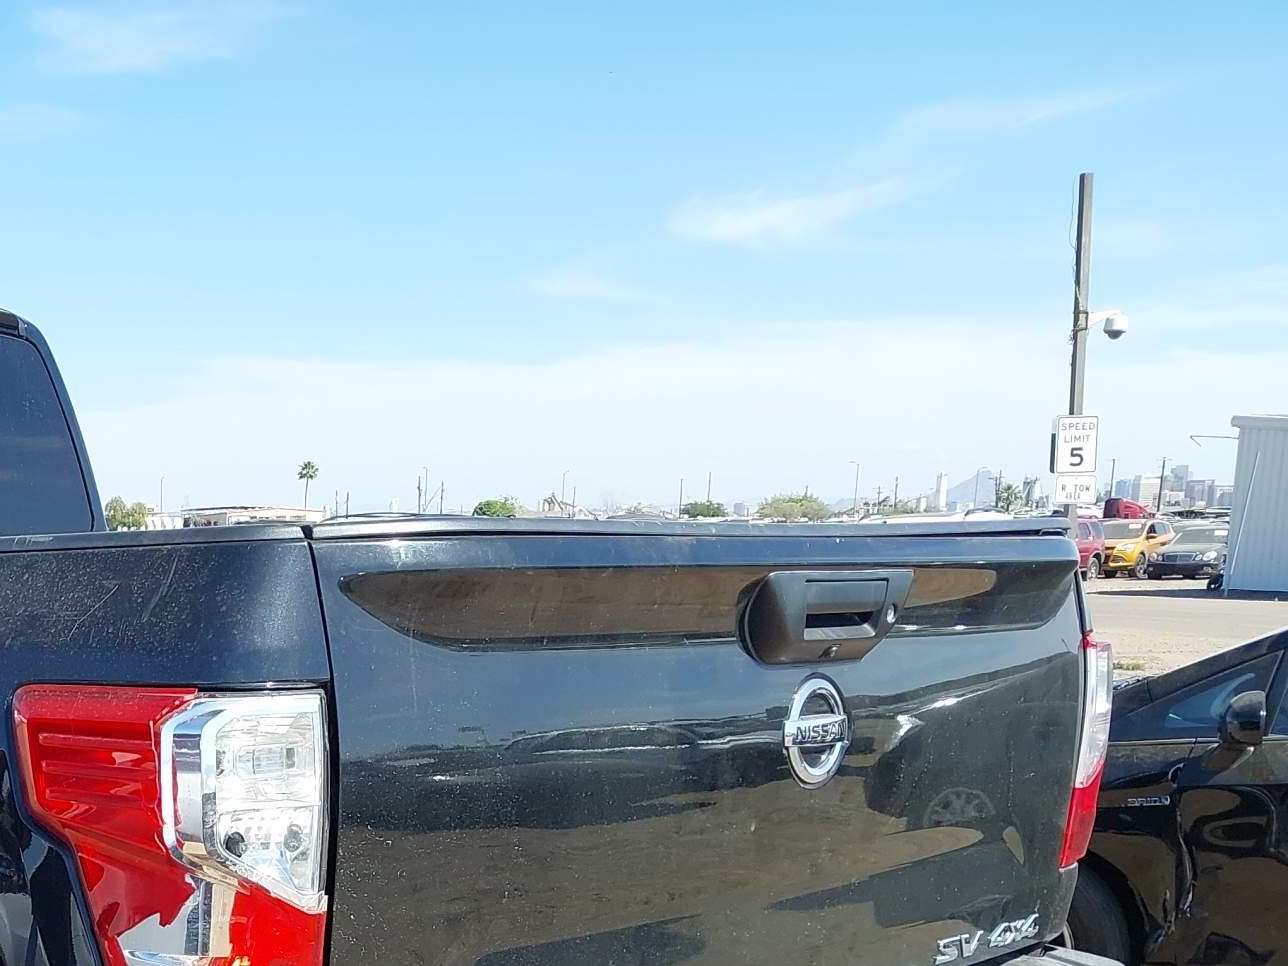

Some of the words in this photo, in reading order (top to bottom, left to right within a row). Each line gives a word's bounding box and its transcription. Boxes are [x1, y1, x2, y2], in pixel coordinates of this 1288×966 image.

[1061, 422, 1096, 431] SPEED
[1063, 434, 1091, 444] LIMIT
[1069, 447, 1084, 467] 5
[795, 721, 846, 741] NISSAN
[932, 930, 984, 965] SV
